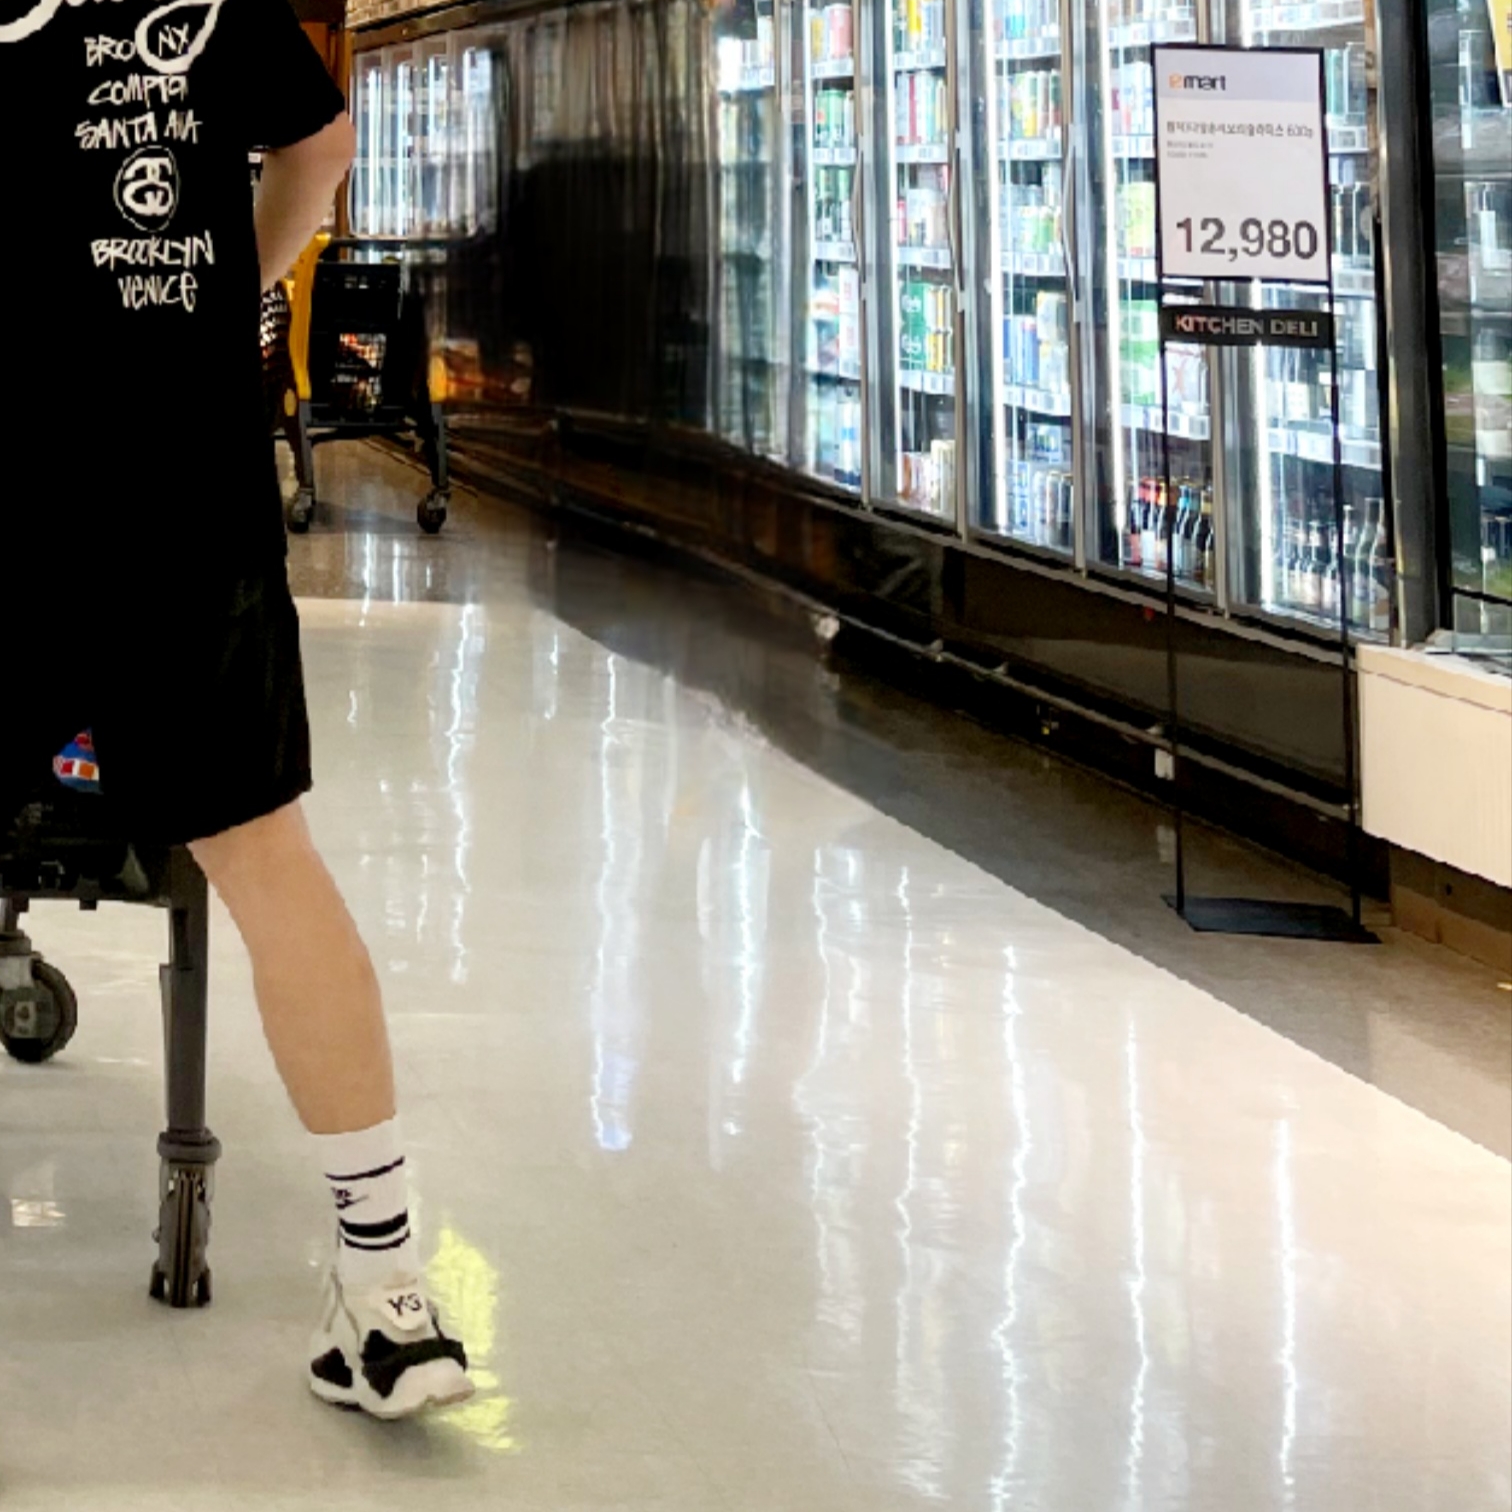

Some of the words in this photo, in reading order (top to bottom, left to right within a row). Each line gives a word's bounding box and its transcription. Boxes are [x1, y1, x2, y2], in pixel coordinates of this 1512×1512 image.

[1169, 73, 1226, 92] emart
[74, 110, 157, 150] SANTA
[91, 229, 215, 271] BROOKLYN
[1176, 218, 1318, 262] 12,980
[118, 271, 199, 313] VENICE
[1175, 314, 1264, 335] KITCHEN
[1270, 319, 1318, 336] DELI
